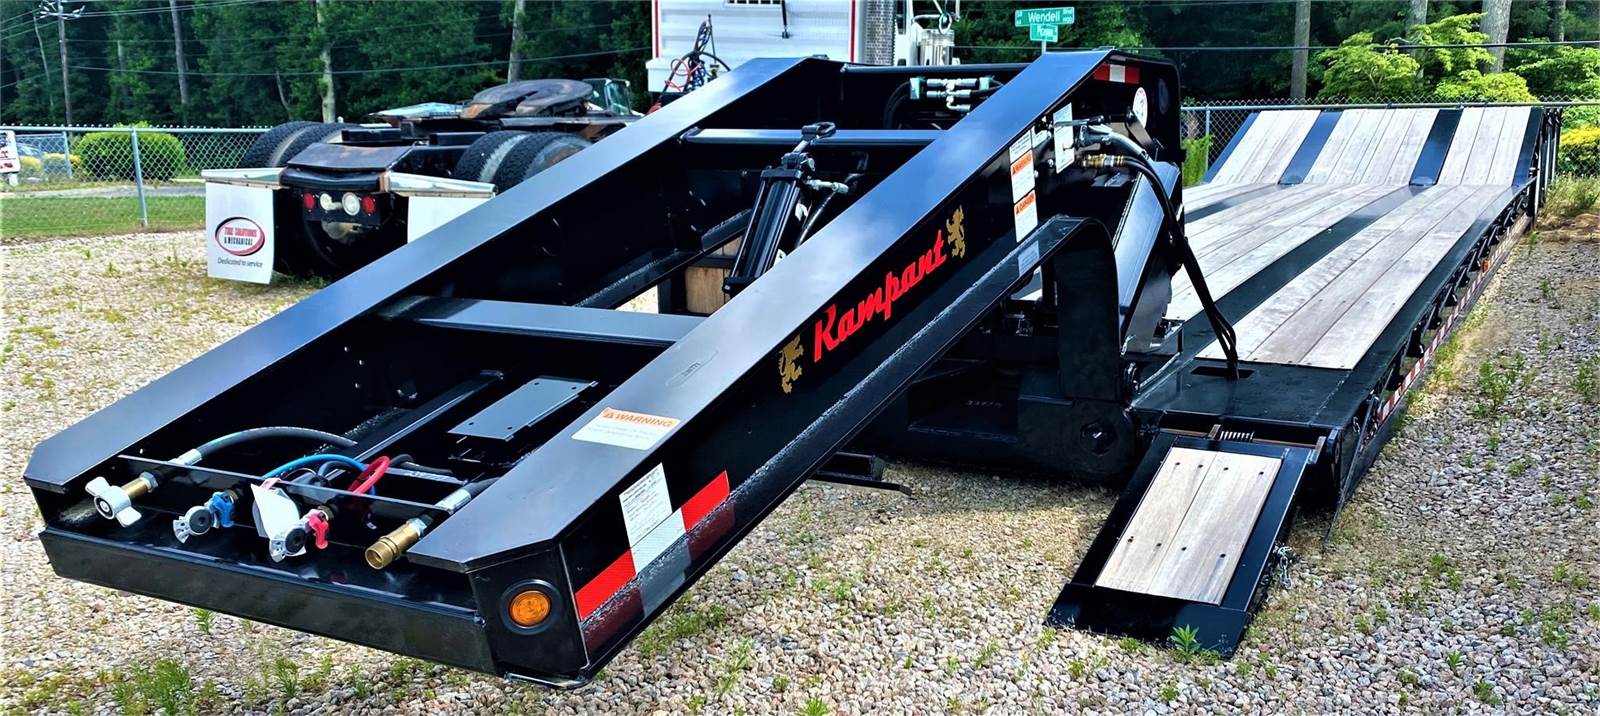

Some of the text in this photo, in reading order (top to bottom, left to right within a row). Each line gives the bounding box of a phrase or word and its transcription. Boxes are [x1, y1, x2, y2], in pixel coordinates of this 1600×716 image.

[1028, 10, 1060, 23] Wendell
[217, 256, 241, 266] Dedicated
[616, 413, 674, 428] WARNING
